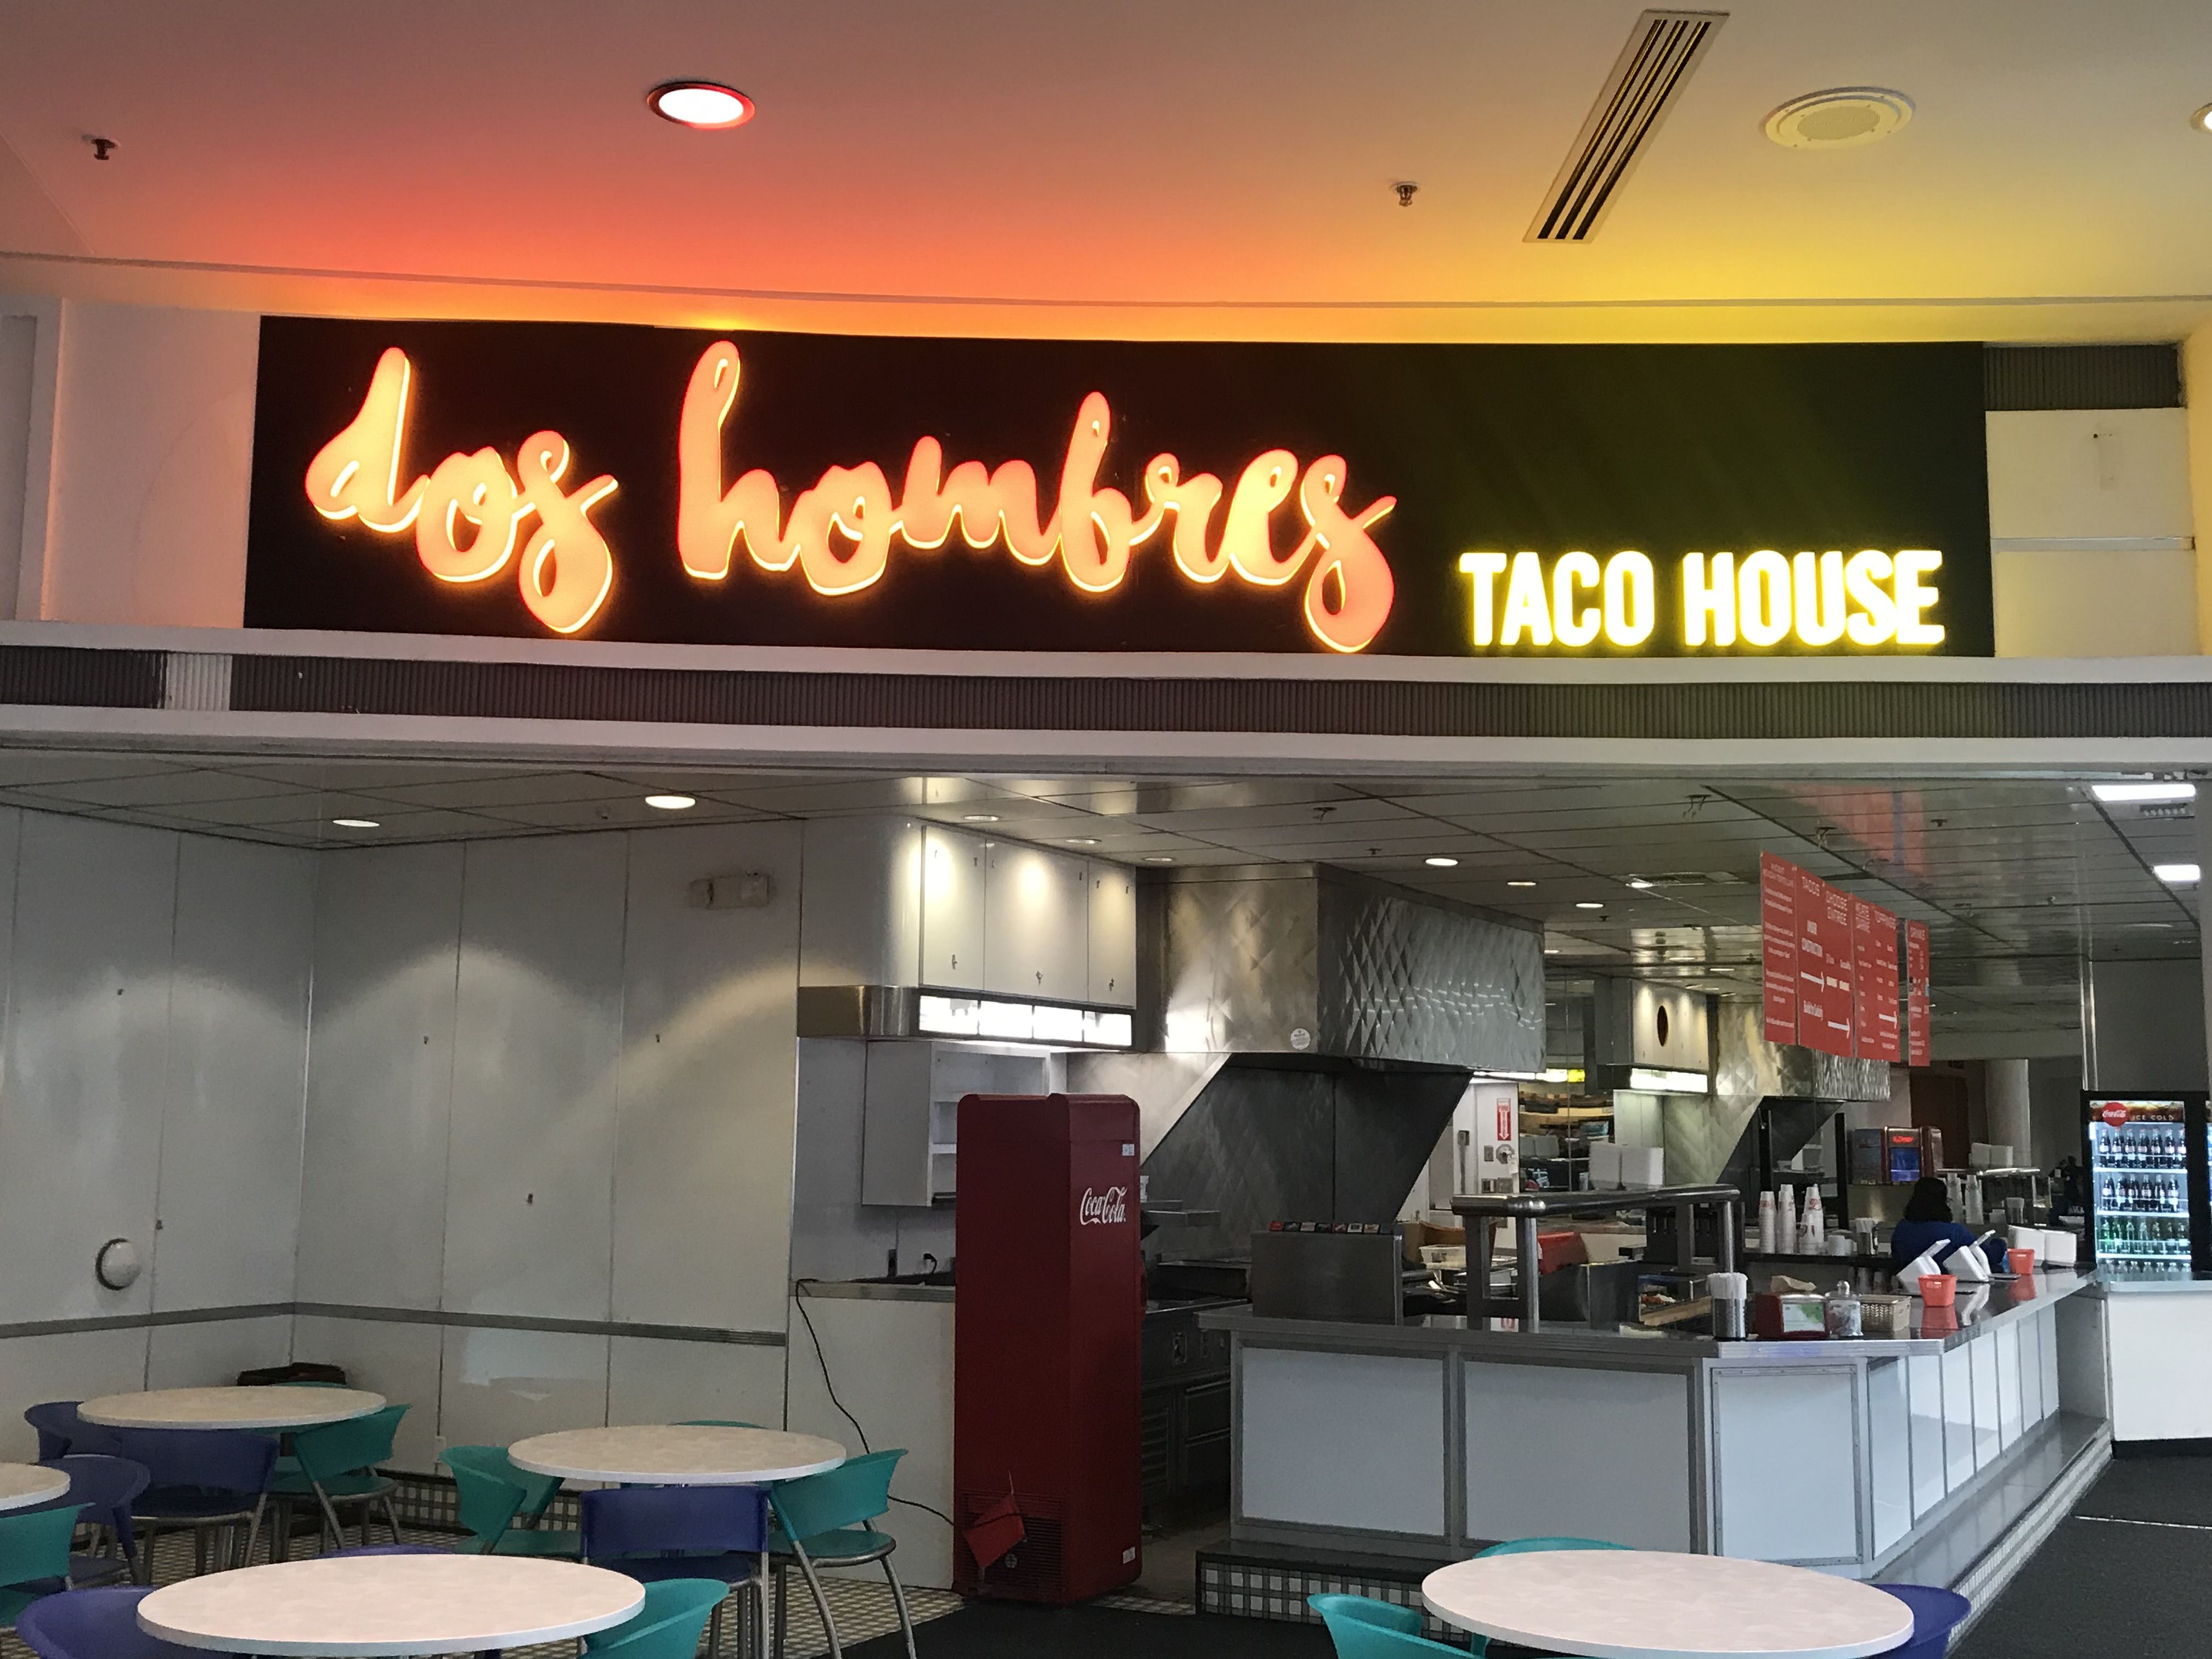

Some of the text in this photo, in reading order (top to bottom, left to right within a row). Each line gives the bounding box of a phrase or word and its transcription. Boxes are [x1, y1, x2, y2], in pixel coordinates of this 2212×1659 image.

[306, 340, 1397, 652] dos hombres
[1459, 549, 1946, 647] TACO HOUSE
